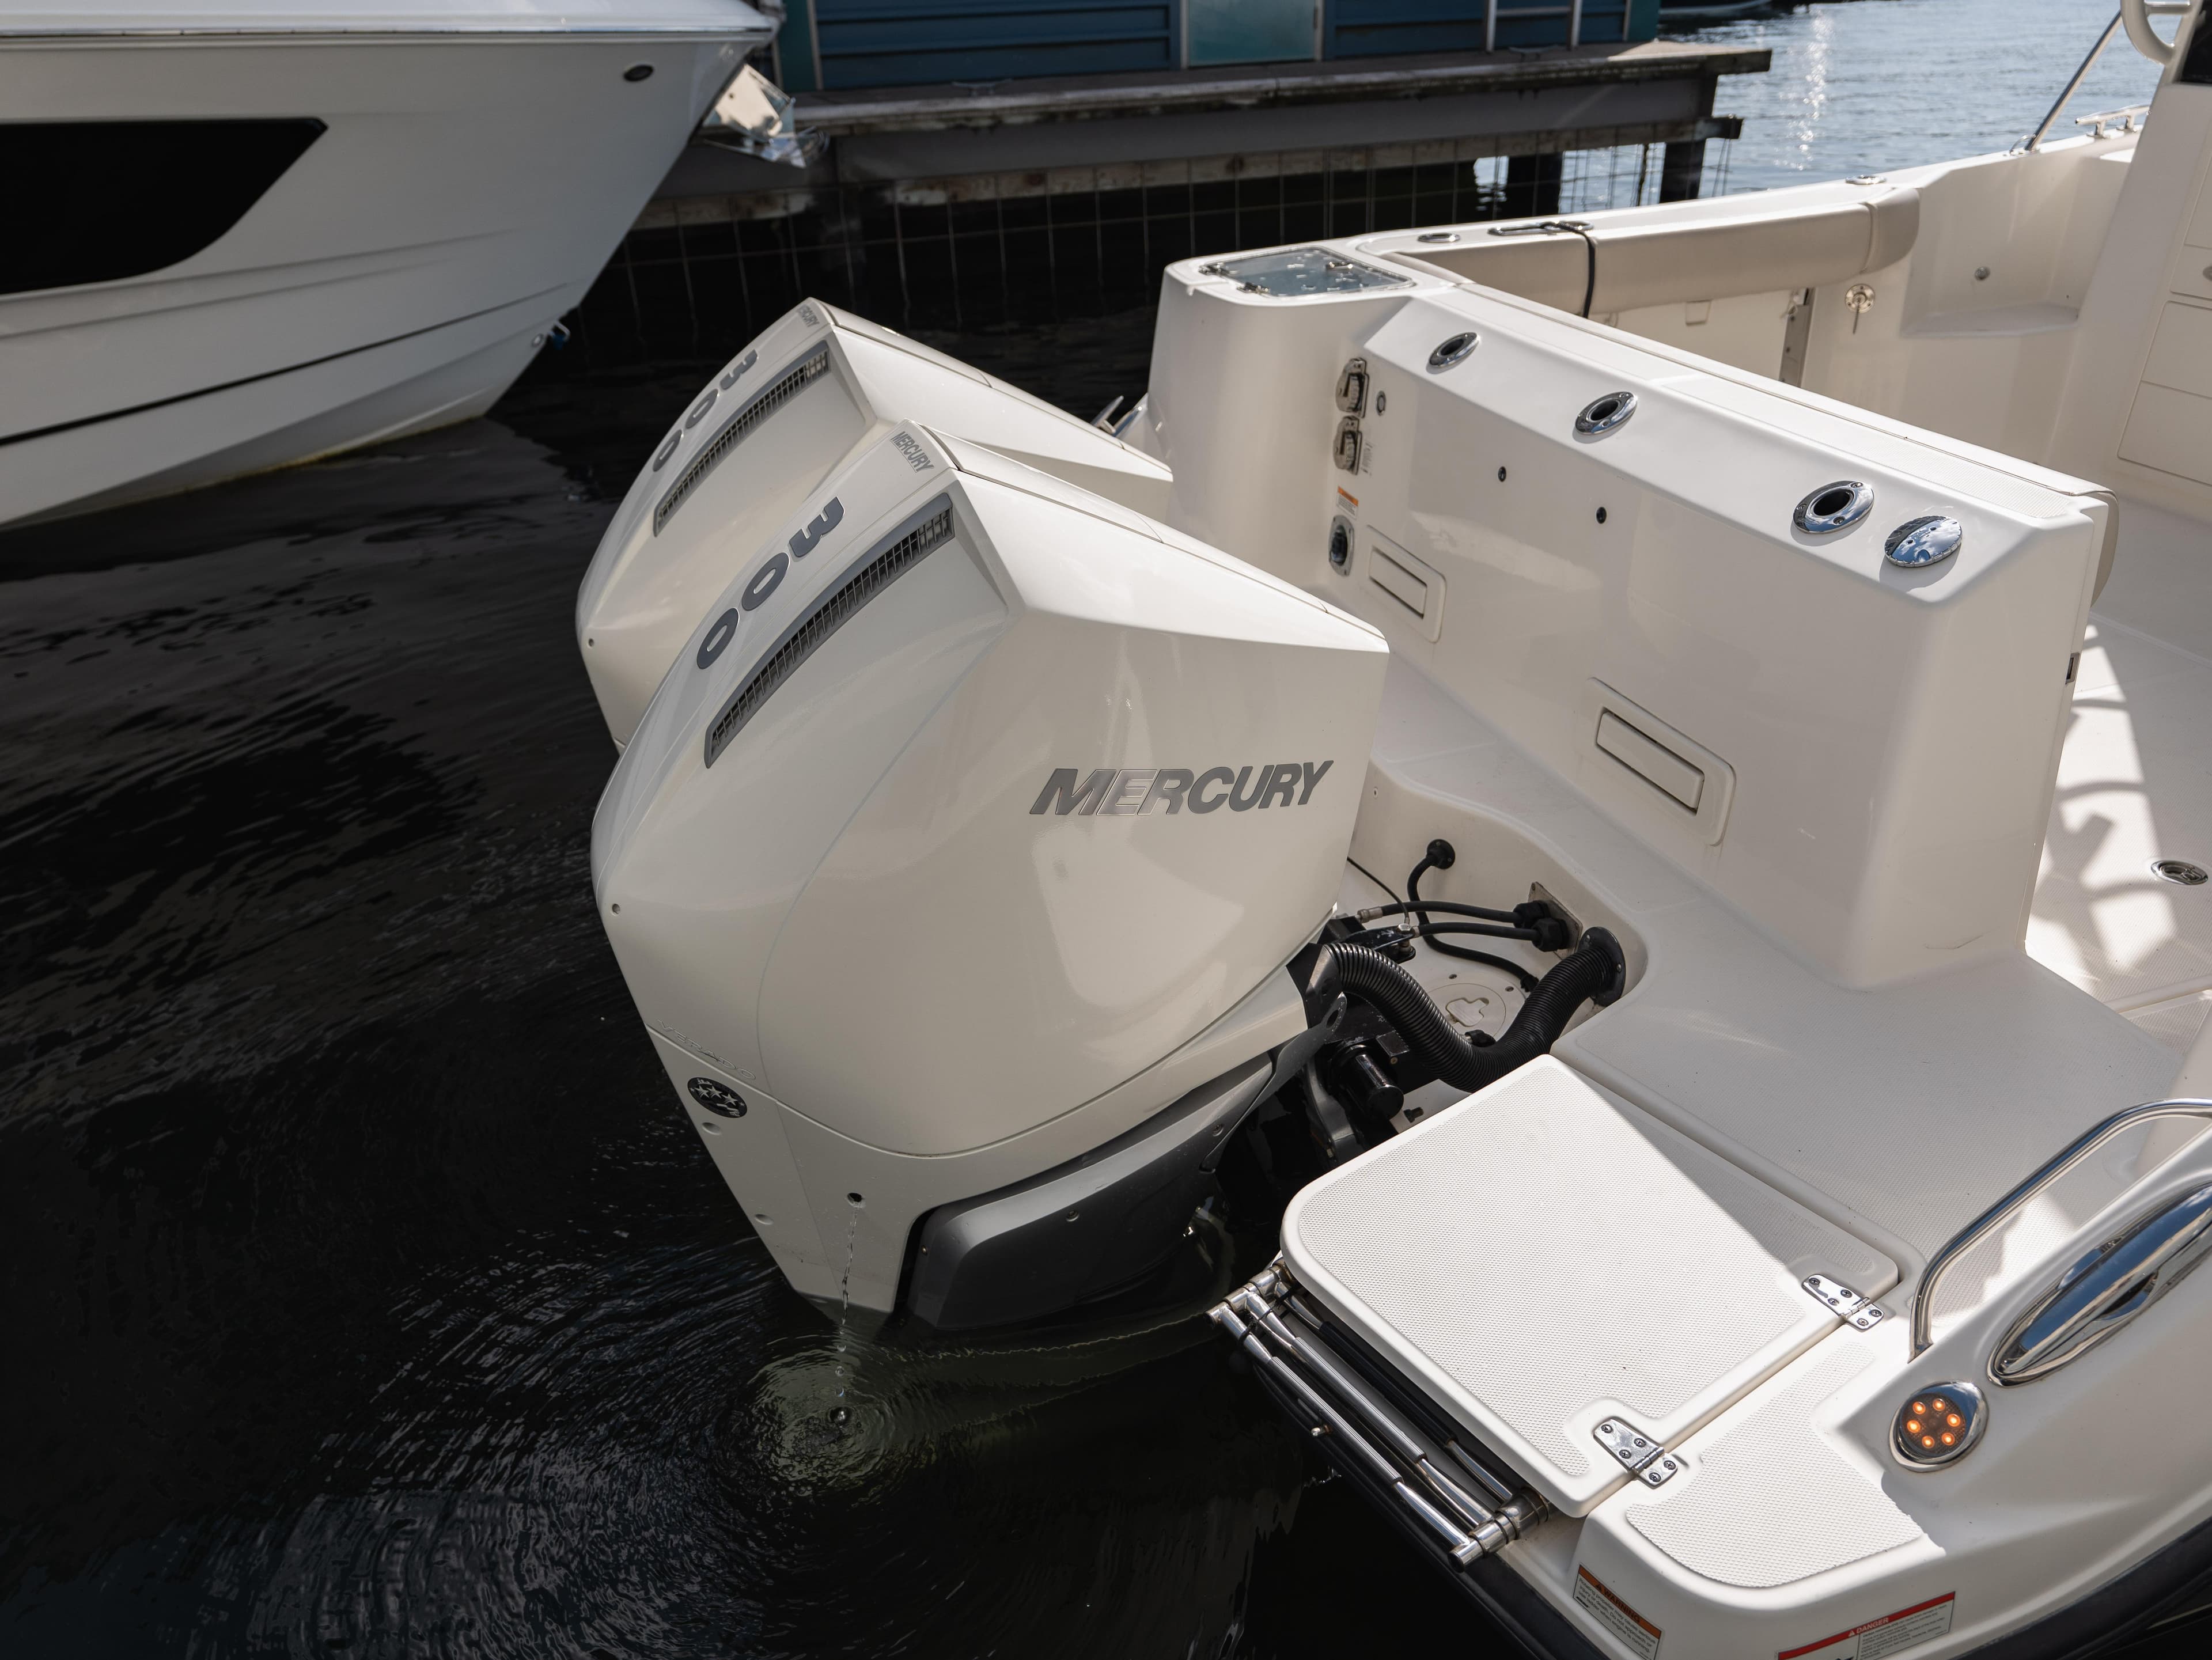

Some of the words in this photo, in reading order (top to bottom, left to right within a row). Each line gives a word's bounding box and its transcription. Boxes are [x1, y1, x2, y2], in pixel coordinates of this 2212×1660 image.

[653, 349, 759, 472] 300
[891, 432, 934, 473] MERCURY
[696, 497, 845, 669] 300
[1029, 760, 1334, 816] MERCURY
[1603, 1589, 1641, 1623] WARNING
[1856, 1617, 1889, 1634] DANGER
